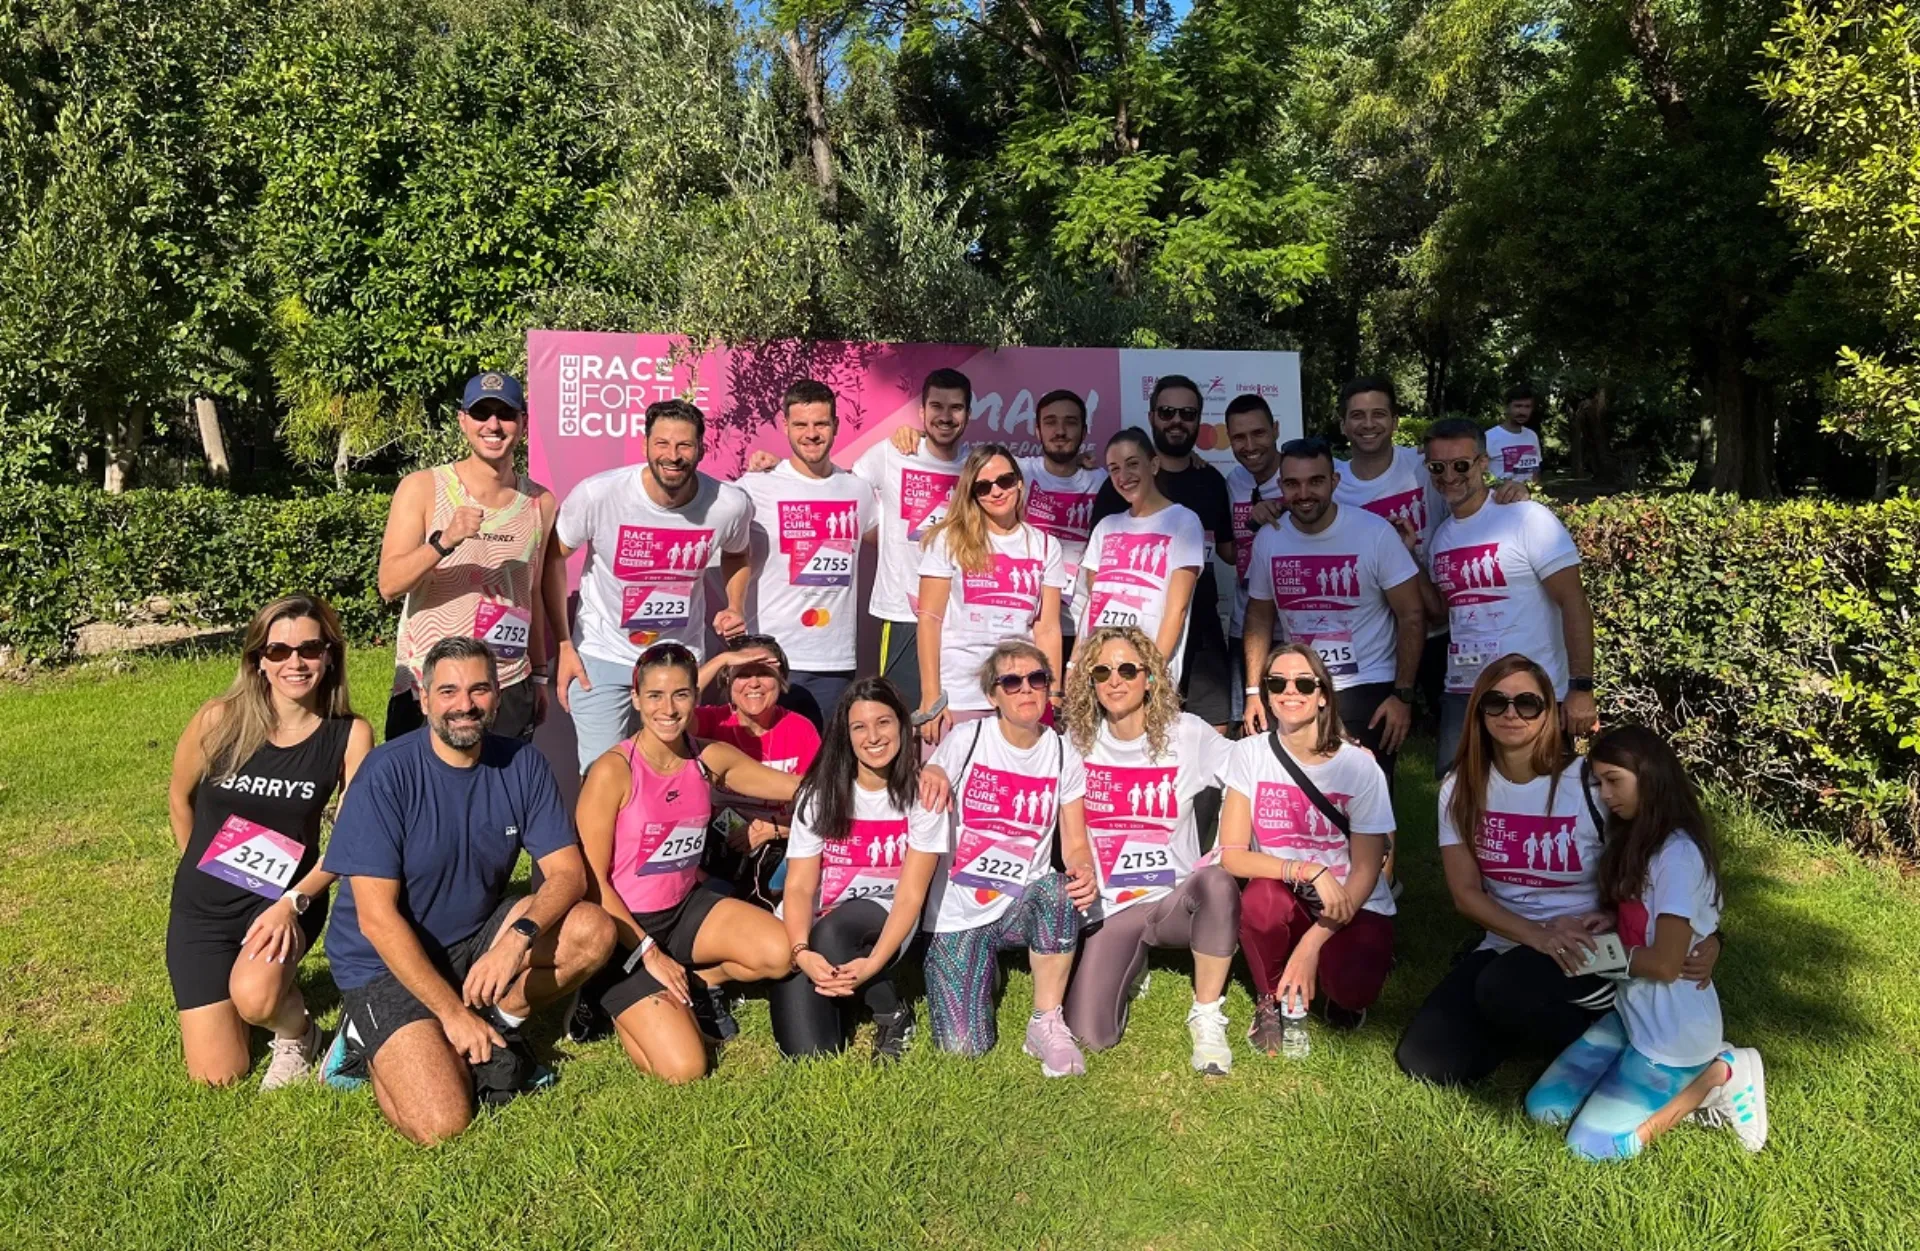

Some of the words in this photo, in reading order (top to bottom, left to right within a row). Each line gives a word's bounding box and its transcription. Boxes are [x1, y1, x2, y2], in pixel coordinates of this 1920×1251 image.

[582, 355, 674, 381] RACE
[561, 356, 579, 435] GREECE
[582, 384, 645, 409] FOR
[652, 385, 711, 411] THE
[581, 412, 646, 437] CUR
[905, 473, 932, 482] RACE
[782, 504, 811, 513] RACE
[783, 512, 804, 521] FOR
[806, 512, 822, 521] THE
[482, 533, 515, 542] TERREX
[623, 530, 654, 541] RACE
[622, 540, 644, 550] FOR
[645, 541, 664, 551] THE
[813, 557, 848, 571] 2755
[1275, 560, 1302, 569] RACE
[1276, 569, 1294, 578] FOR
[1295, 568, 1313, 578] THE
[643, 601, 685, 616] 3223
[1103, 610, 1138, 626] 2770
[494, 624, 526, 643] 2752
[1321, 647, 1351, 662] 215
[973, 768, 998, 784] RACE
[1103, 781, 1123, 792] THE
[1260, 798, 1282, 808] FOR
[1497, 829, 1519, 841] THE
[662, 834, 703, 857] 2756
[233, 846, 289, 880] 3211
[1121, 850, 1168, 869] 2753
[976, 856, 1024, 880] 3222
